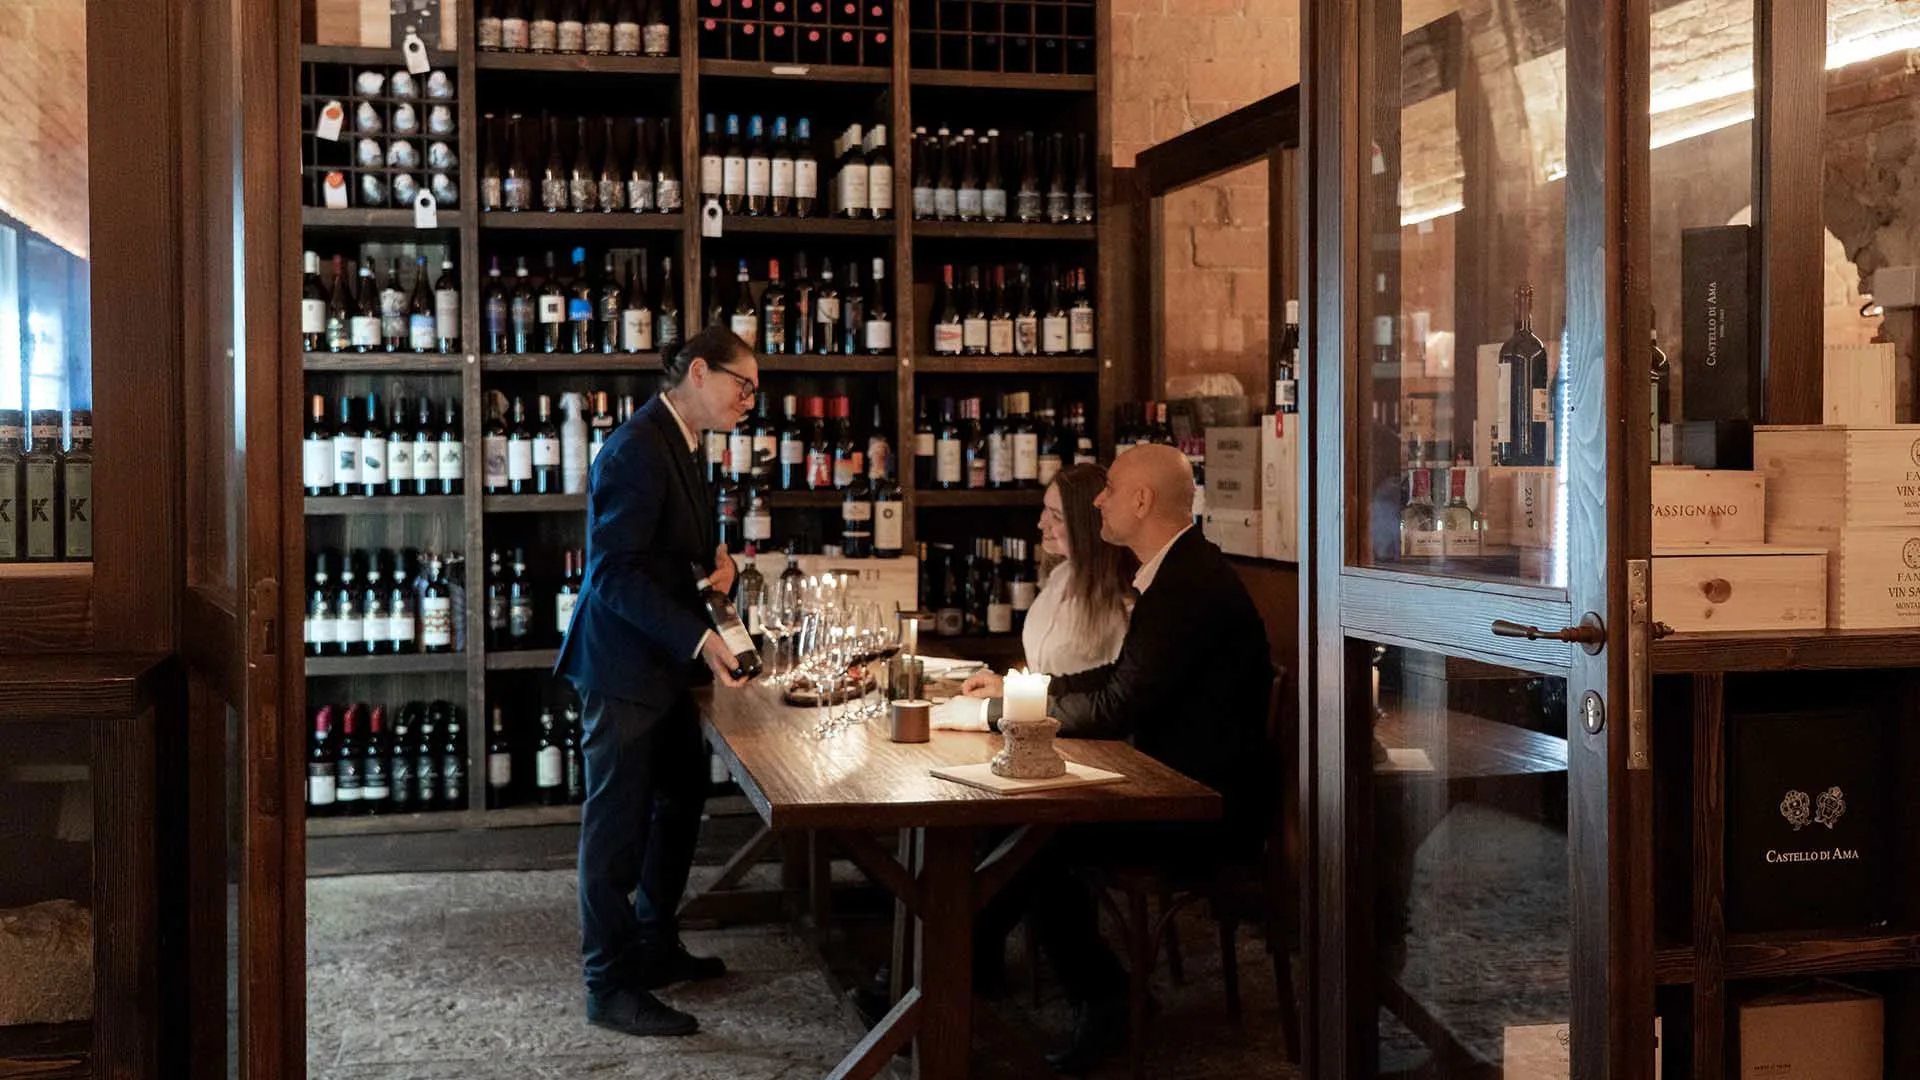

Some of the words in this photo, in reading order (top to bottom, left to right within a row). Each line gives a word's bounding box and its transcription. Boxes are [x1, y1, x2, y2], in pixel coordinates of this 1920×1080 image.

[1896, 486, 1915, 496] VIN
[31, 497, 49, 522] K
[70, 497, 88, 522] K
[1525, 487, 1534, 528] 2019
[1650, 503, 1738, 517] PASSIGNANO
[1888, 587, 1906, 597] VIN
[1766, 849, 1818, 863] CASTELLO
[1832, 847, 1860, 860] AMA
